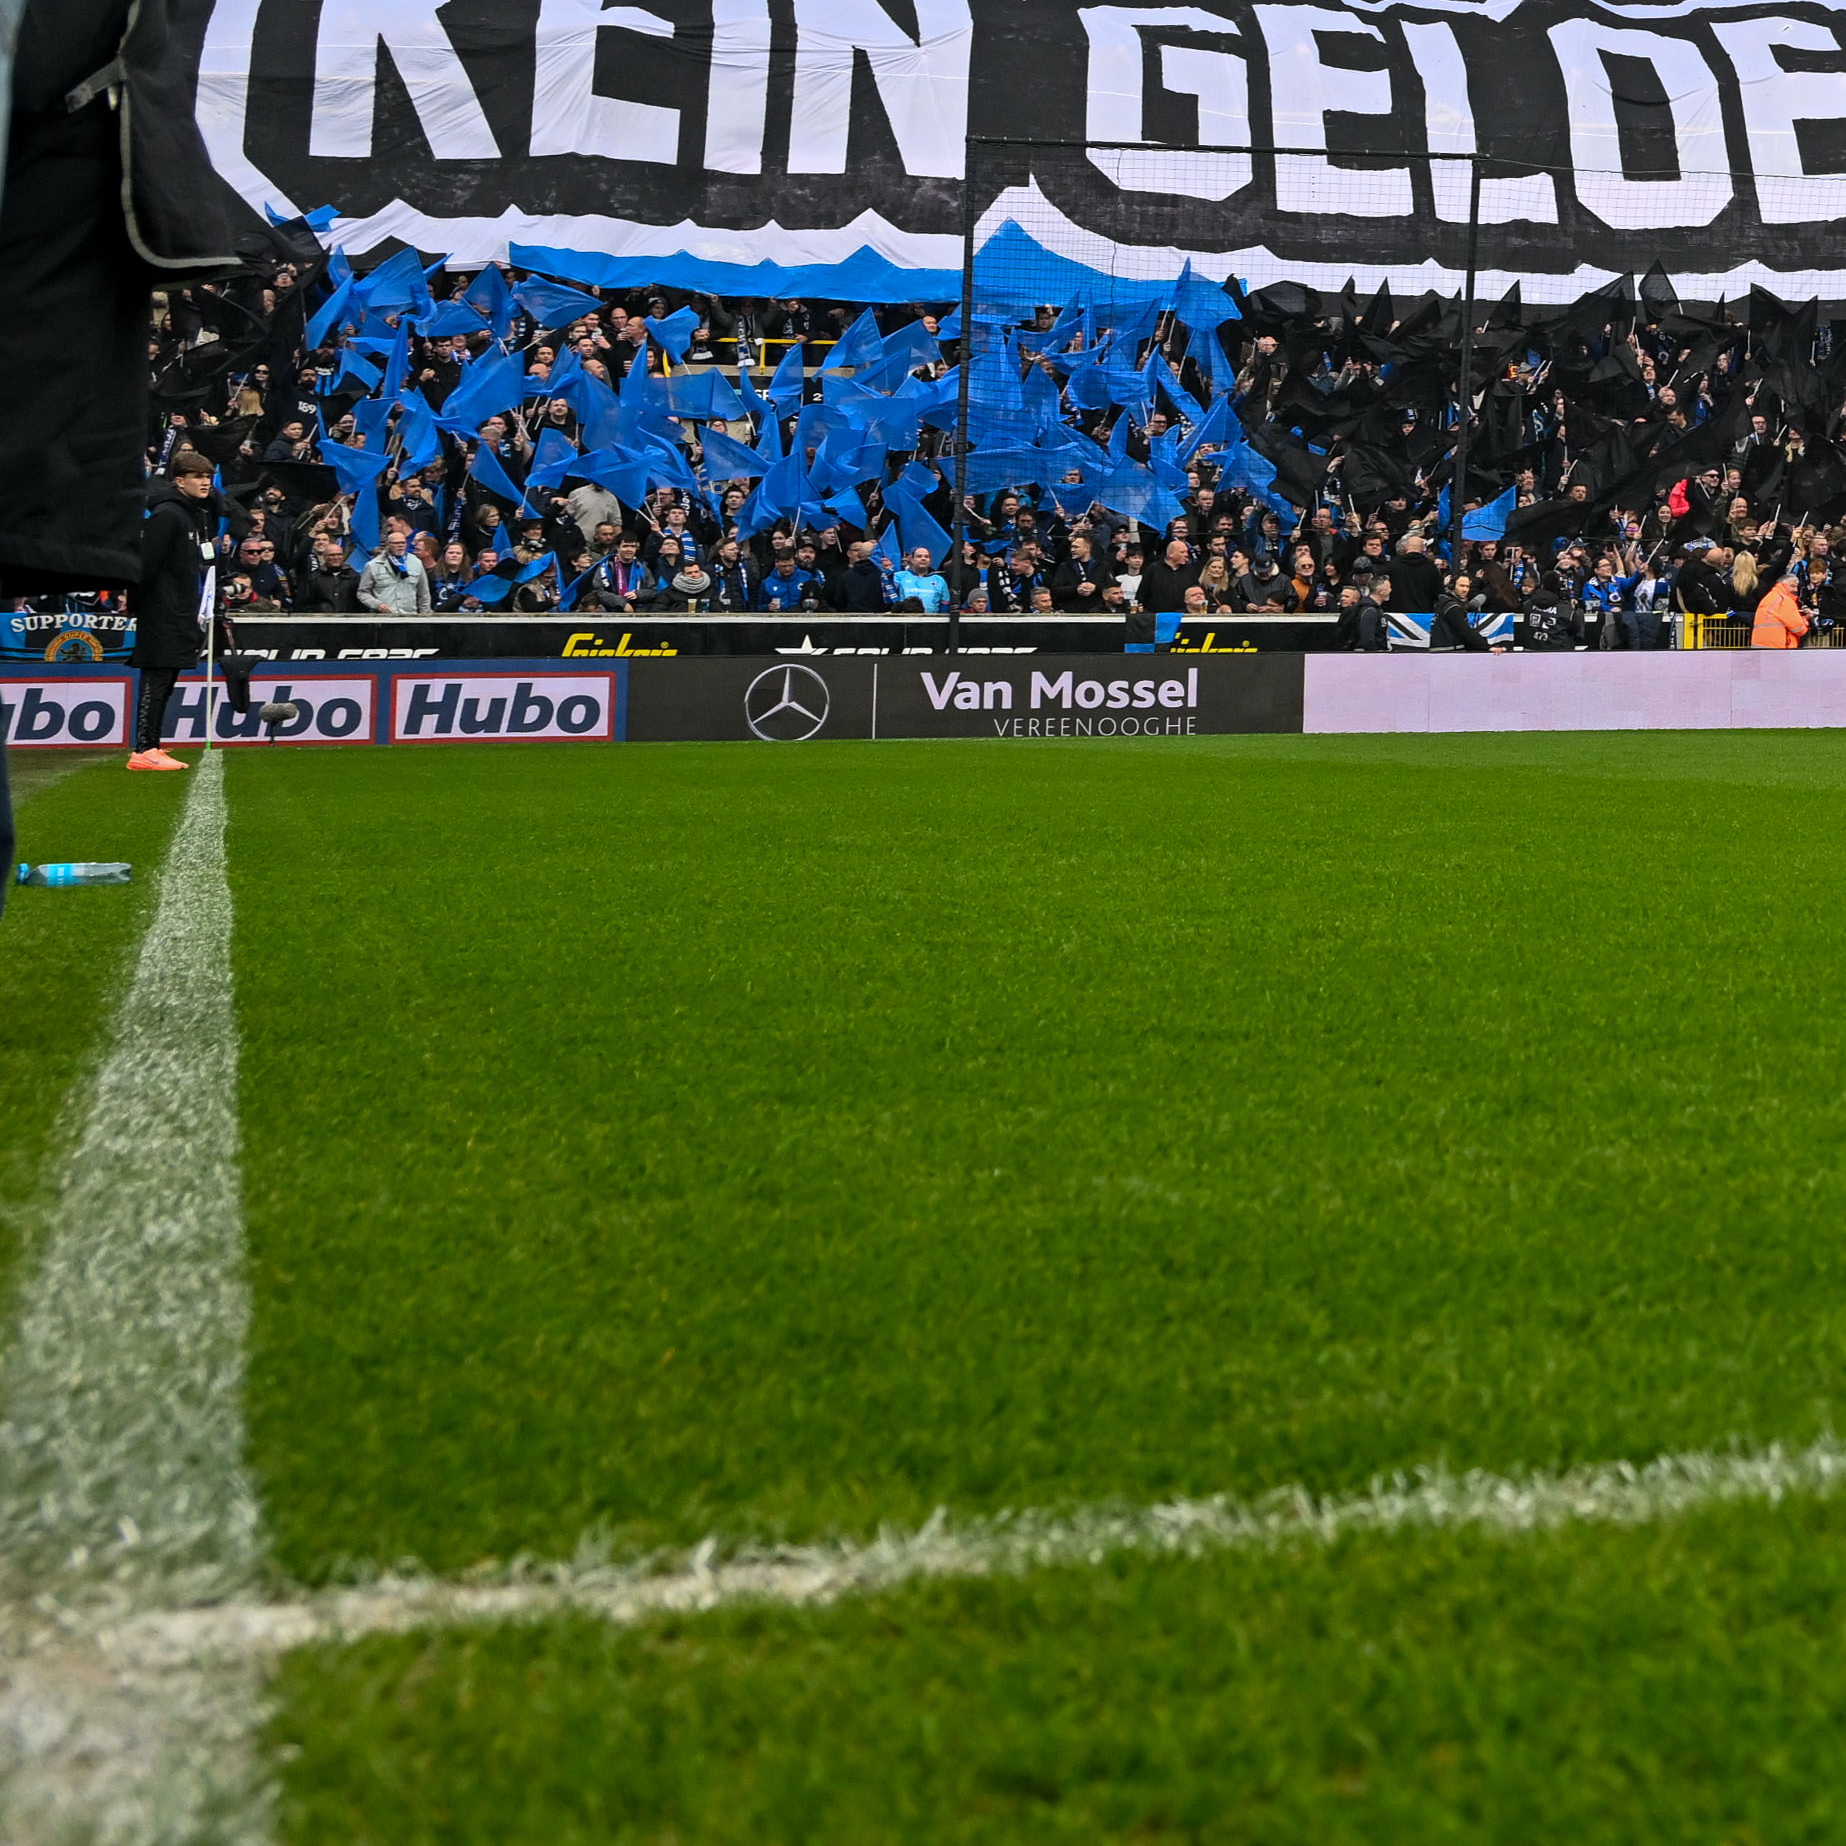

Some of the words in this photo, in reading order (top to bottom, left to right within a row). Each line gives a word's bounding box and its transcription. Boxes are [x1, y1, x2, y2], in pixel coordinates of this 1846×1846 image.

[2, 687, 116, 741] bo
[160, 685, 362, 739] Hubo
[403, 682, 600, 736] Hubo
[920, 671, 1012, 710] Van
[1030, 667, 1198, 709] Mossel
[993, 716, 1198, 737] VEREENOOGHE
